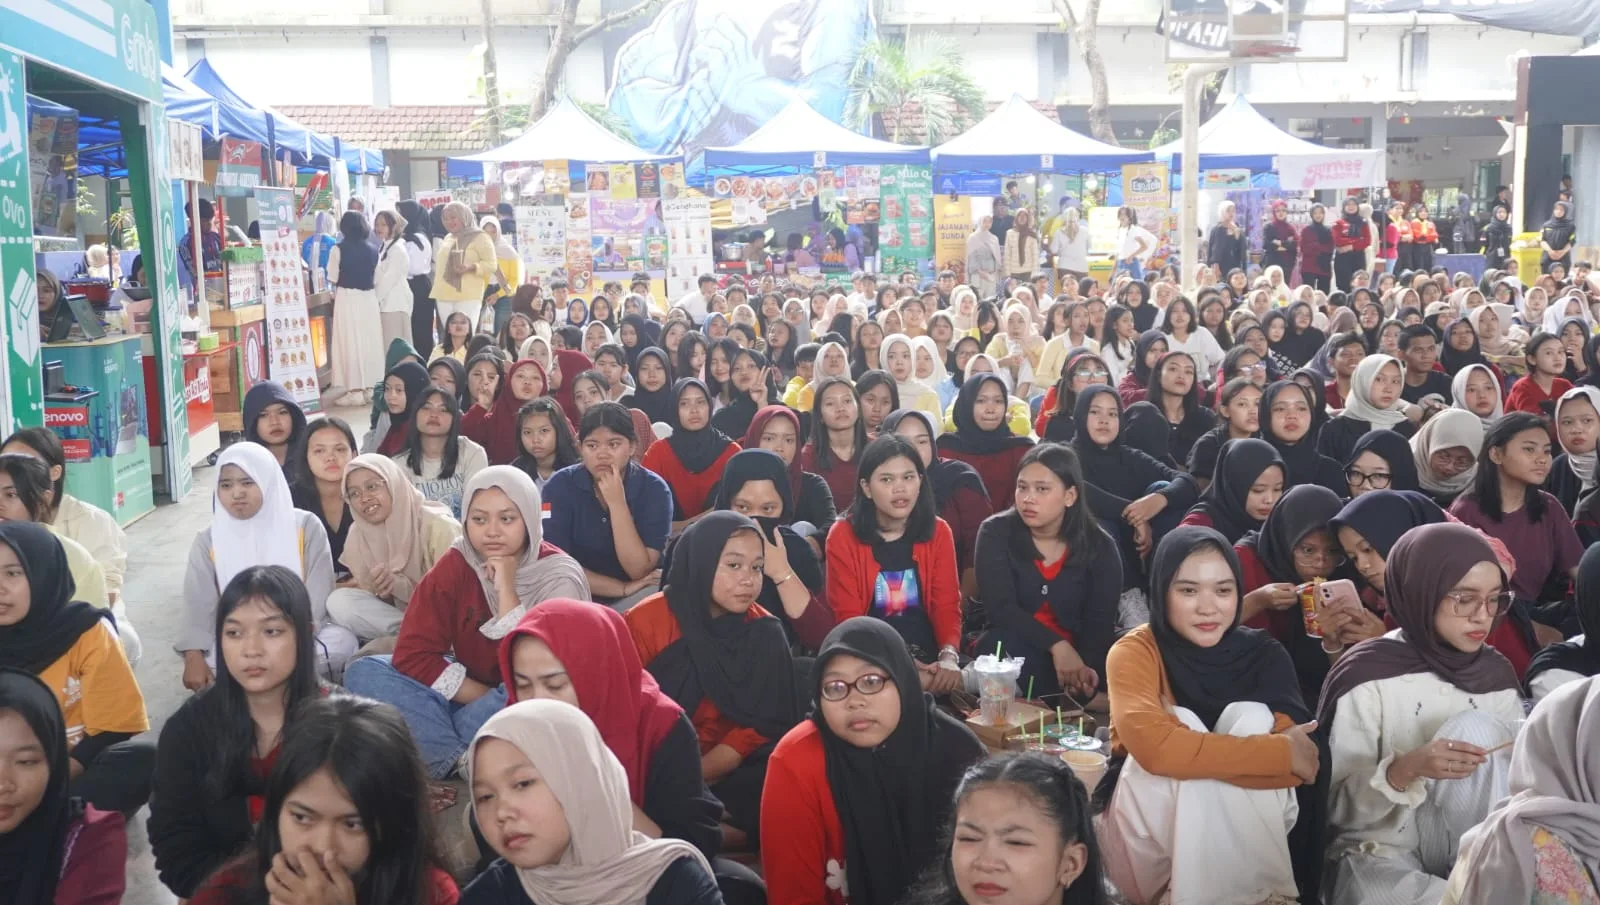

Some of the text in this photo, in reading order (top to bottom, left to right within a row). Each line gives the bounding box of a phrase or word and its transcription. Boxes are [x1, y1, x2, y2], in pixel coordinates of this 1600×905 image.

[121, 13, 157, 82] Grab
[527, 209, 555, 217] MENU
[44, 412, 84, 422] enovo
